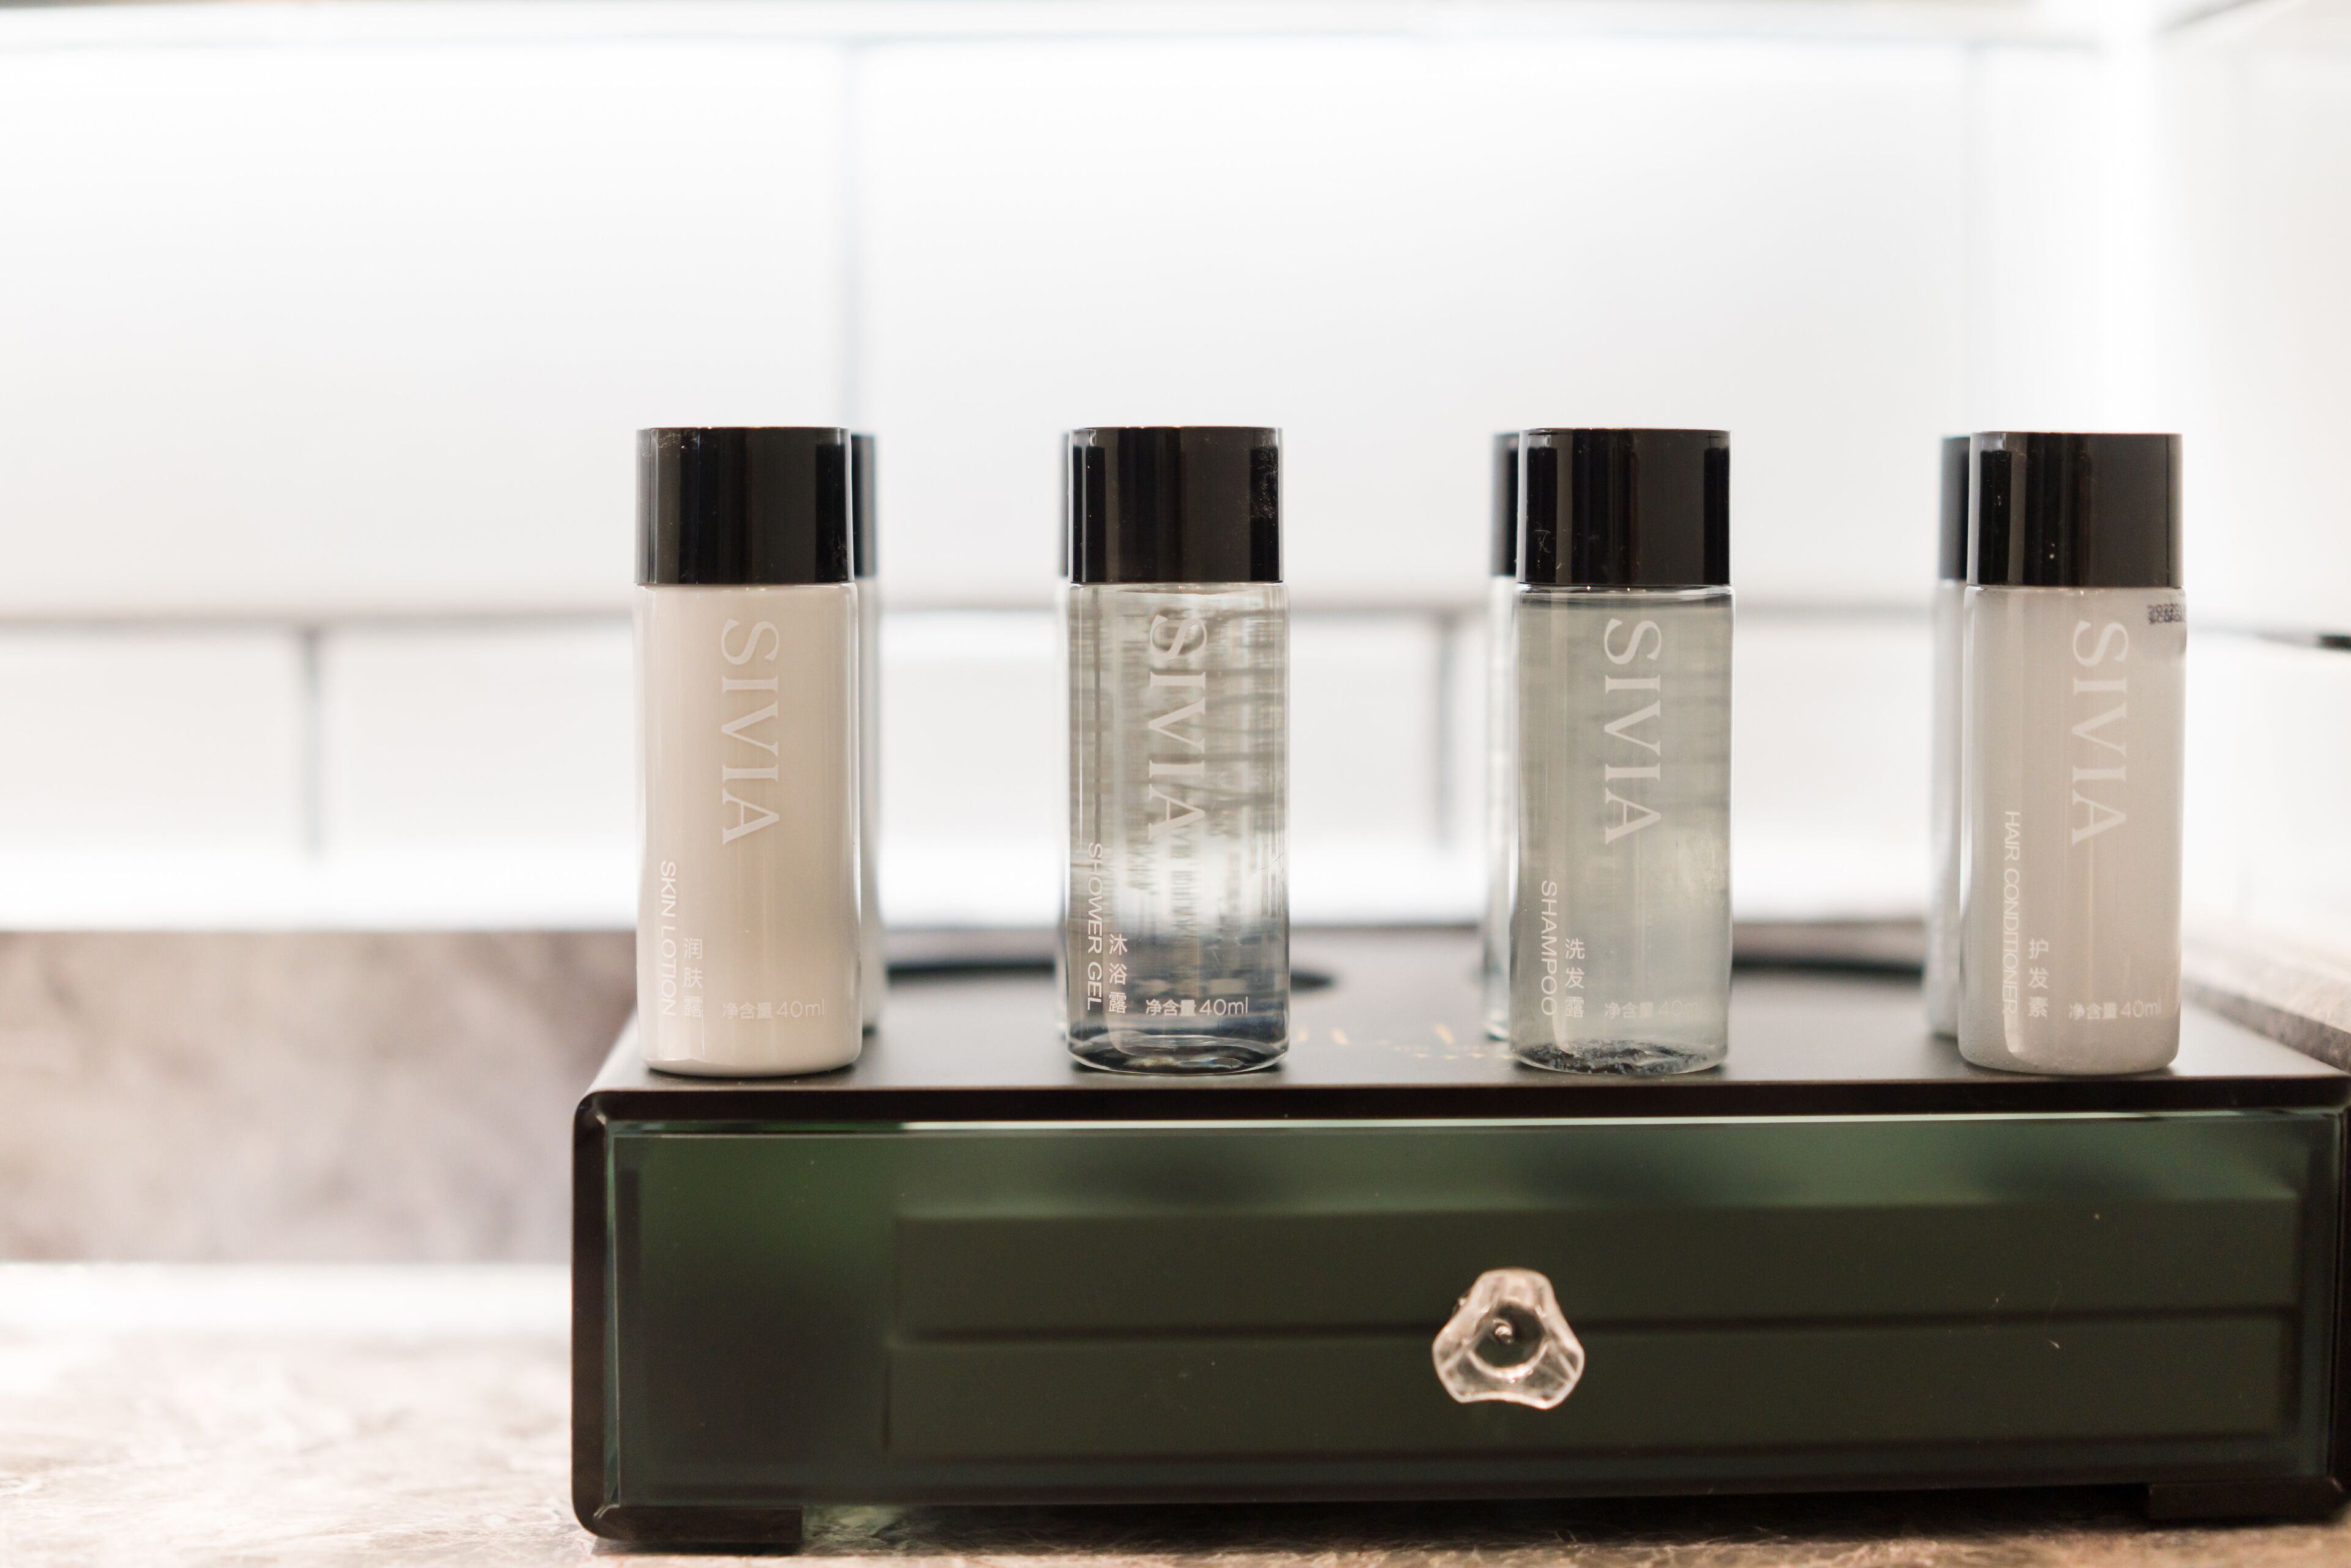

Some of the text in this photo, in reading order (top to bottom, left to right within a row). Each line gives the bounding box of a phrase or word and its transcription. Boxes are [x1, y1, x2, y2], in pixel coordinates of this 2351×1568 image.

[721, 618, 780, 846] SIVIA
[1148, 614, 1207, 841] SIVIA
[1603, 618, 1662, 844] SIVIA
[2072, 620, 2129, 846] SIVIA
[661, 860, 676, 1016] SKIN LOTION
[683, 937, 703, 1018] 润肤露
[1087, 842, 1102, 1010] SHOWER GEL
[1108, 933, 1128, 1014] 沐浴露
[1541, 880, 1557, 1015] SHAMPOO
[1565, 938, 1585, 1018] 洗发露
[2001, 811, 2020, 1014] HAIR CONDITIONER
[2028, 938, 2049, 1018] 护发素
